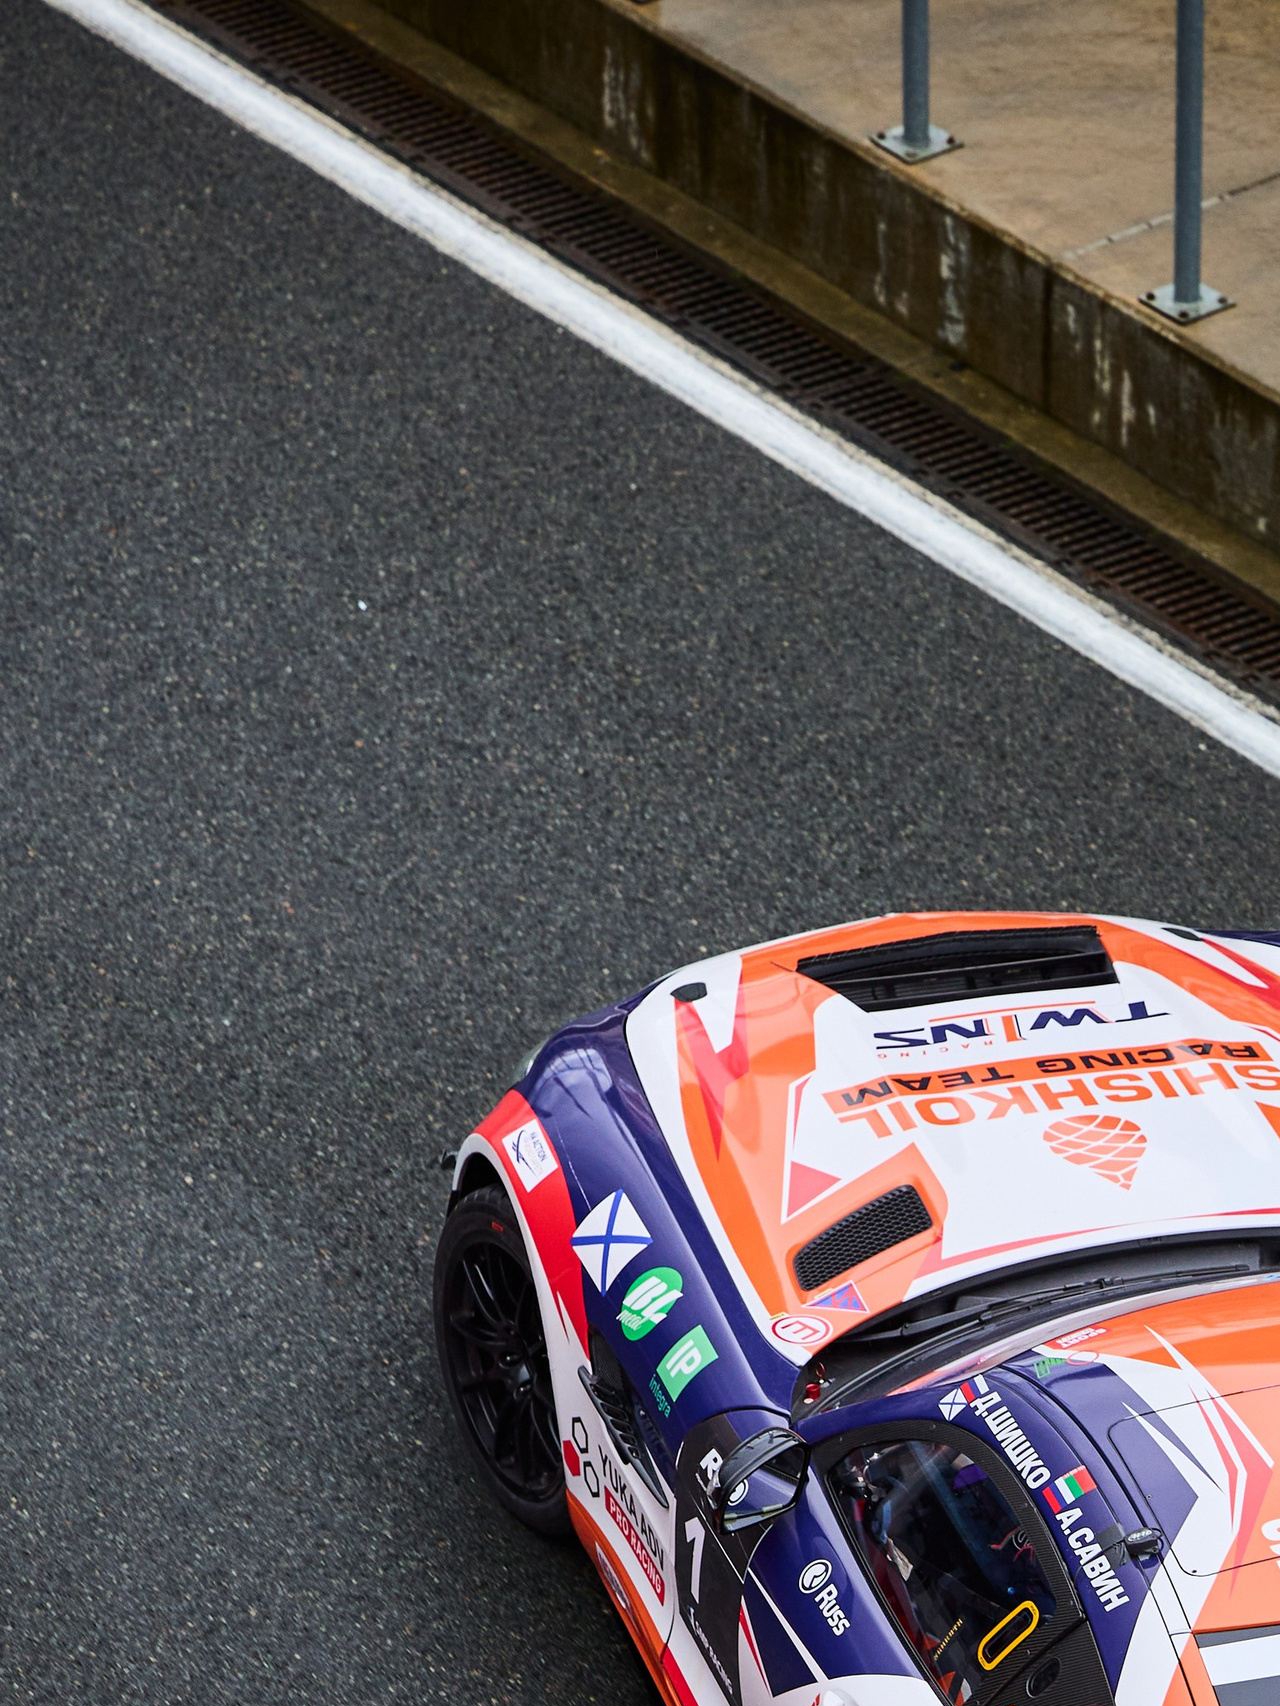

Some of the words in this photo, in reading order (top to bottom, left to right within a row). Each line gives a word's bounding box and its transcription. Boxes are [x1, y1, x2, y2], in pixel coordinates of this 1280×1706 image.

[873, 1001, 1171, 1050] TWINS
[877, 1040, 993, 1059] RACING
[1041, 1043, 1259, 1073] RACING
[842, 1067, 1014, 1106] TEAM
[665, 1339, 702, 1378] IP
[649, 1374, 671, 1418] integra
[969, 1391, 1051, 1489] Д.ШИШКО
[598, 1444, 638, 1526] YUKA
[641, 1515, 664, 1570] ADV
[609, 1497, 629, 1535] PRO
[630, 1533, 662, 1594] RACING
[685, 1517, 706, 1604] 1
[1055, 1507, 1130, 1612] А.САВИН
